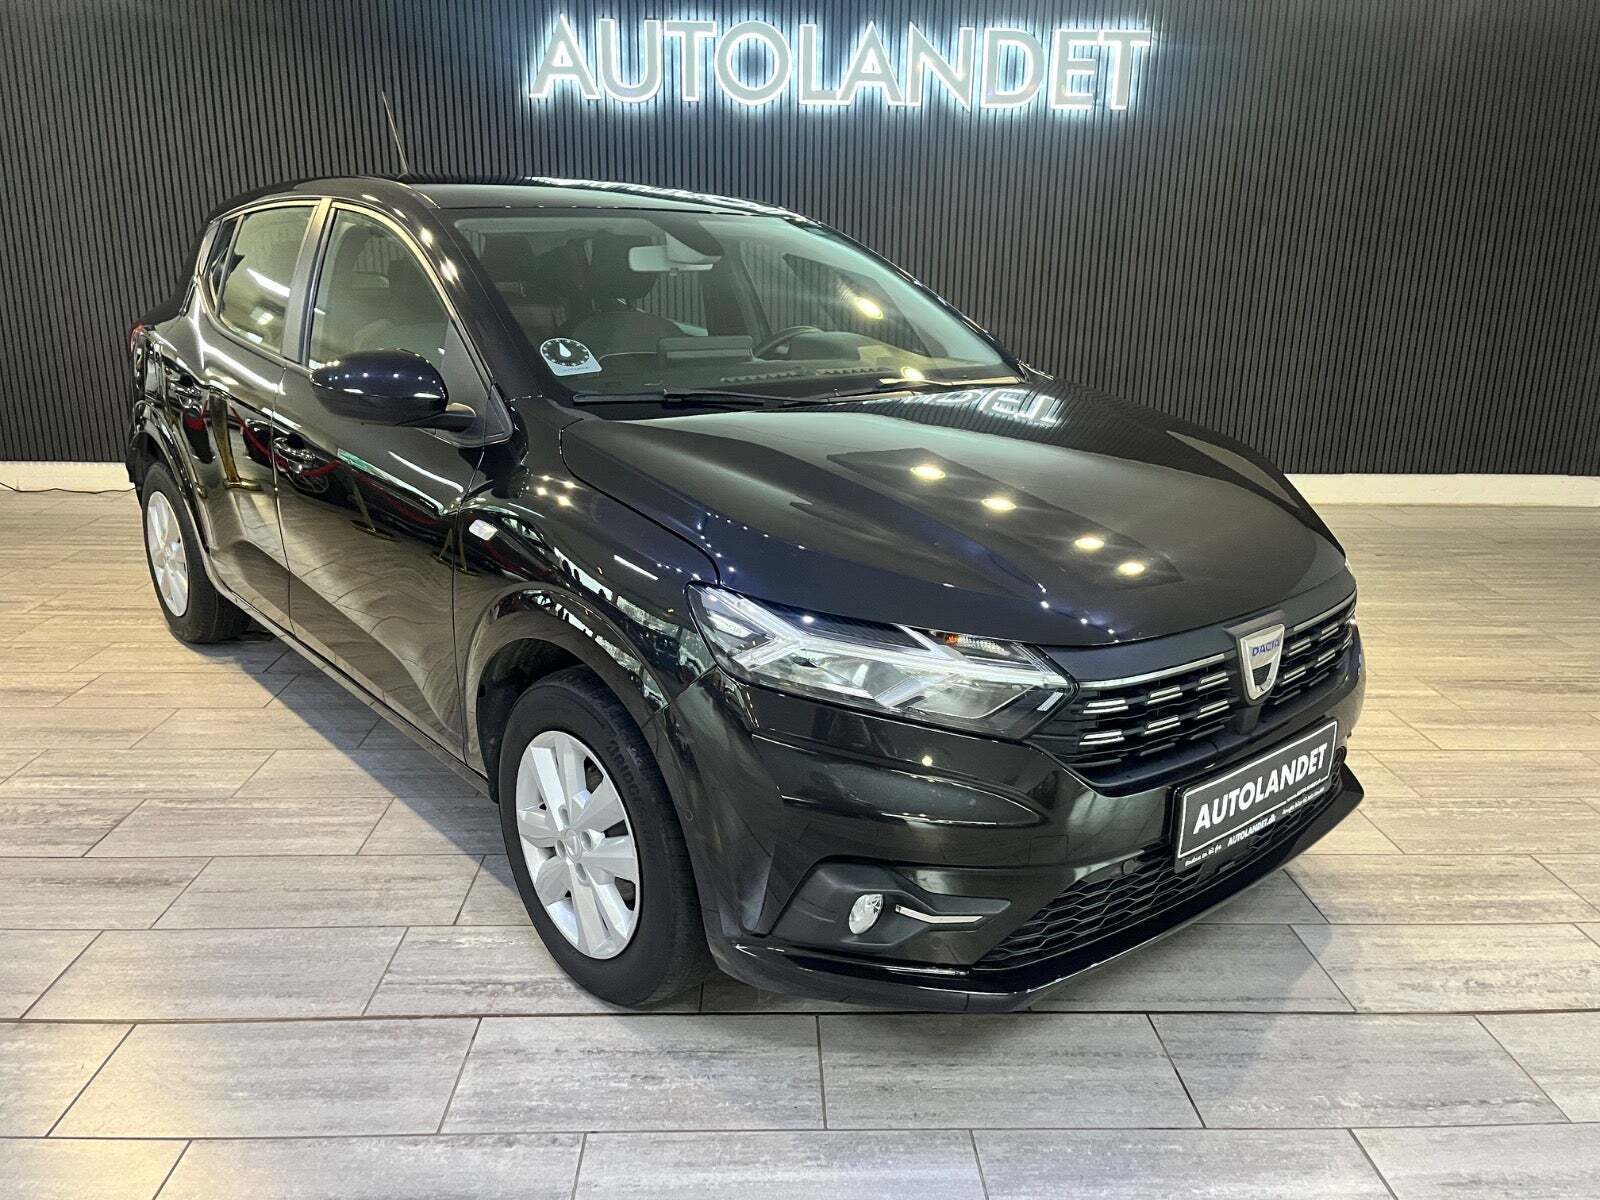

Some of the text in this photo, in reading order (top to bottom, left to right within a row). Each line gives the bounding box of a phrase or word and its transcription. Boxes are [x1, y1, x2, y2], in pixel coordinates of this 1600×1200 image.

[528, 15, 1153, 112] AUTOLANDET
[1252, 639, 1280, 656] DACIA
[1193, 743, 1328, 834] AUTOLANDET
